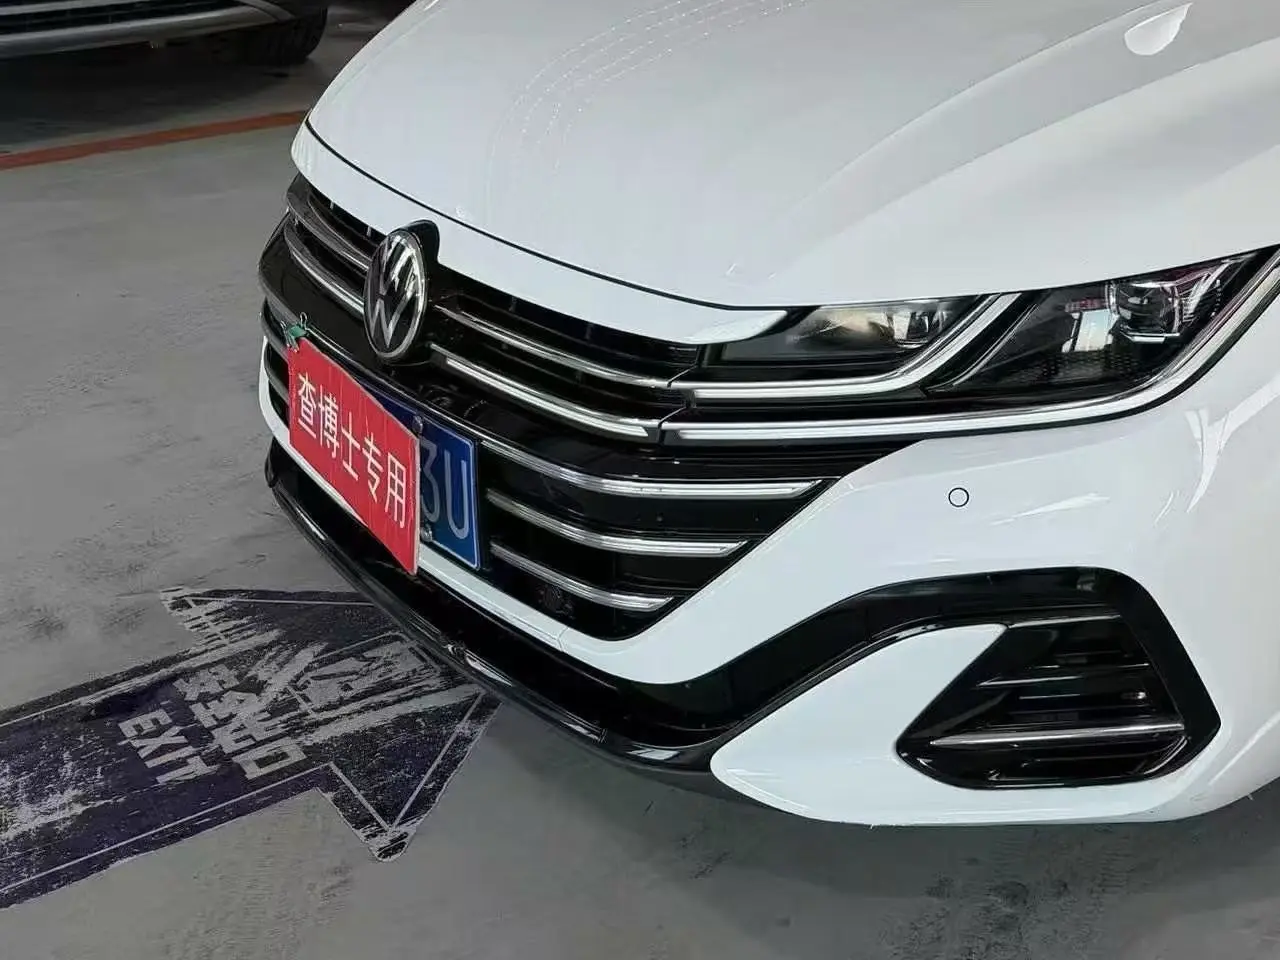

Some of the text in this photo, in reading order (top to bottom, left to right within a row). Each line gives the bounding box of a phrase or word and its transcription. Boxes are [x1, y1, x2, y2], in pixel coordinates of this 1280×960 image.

[298, 371, 407, 529] 查博士专用
[117, 708, 221, 784] EXIT
